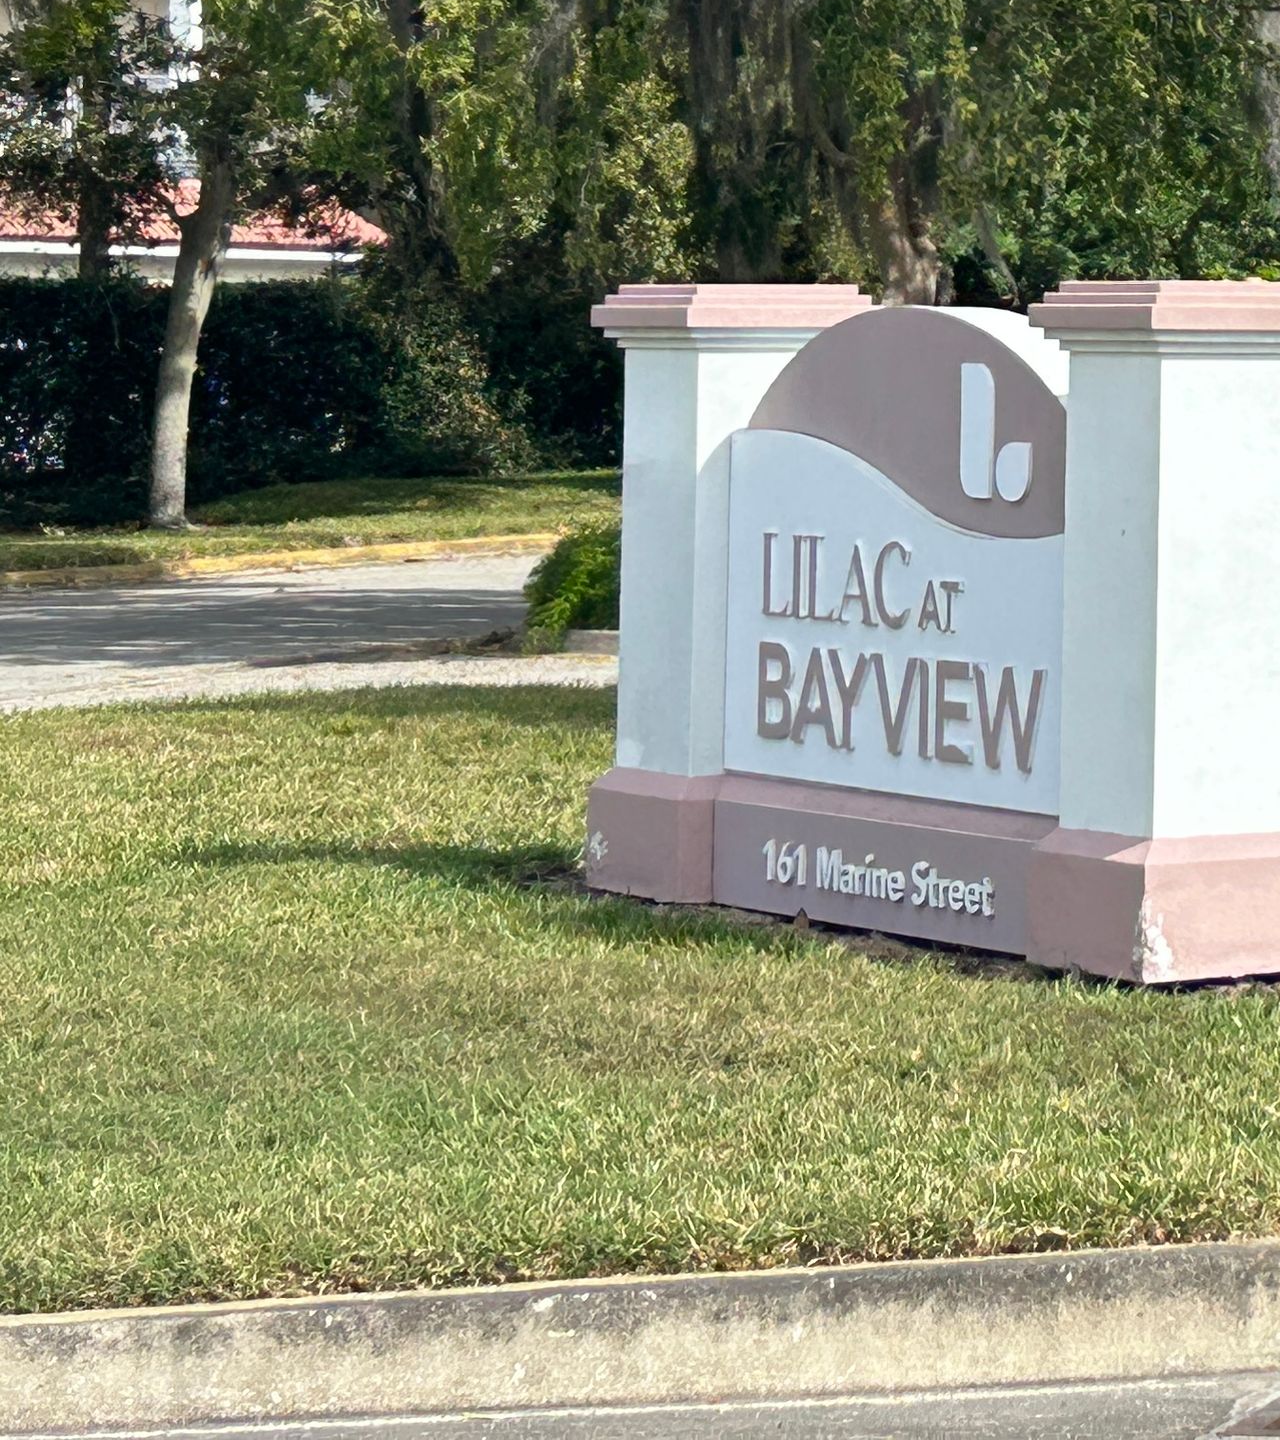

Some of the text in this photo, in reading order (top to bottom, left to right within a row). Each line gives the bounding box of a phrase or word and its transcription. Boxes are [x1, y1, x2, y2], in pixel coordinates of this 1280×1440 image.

[761, 531, 965, 634] LILAC AT
[757, 640, 1048, 775] BAYVIEW
[762, 838, 996, 917] 161 Marine Street
